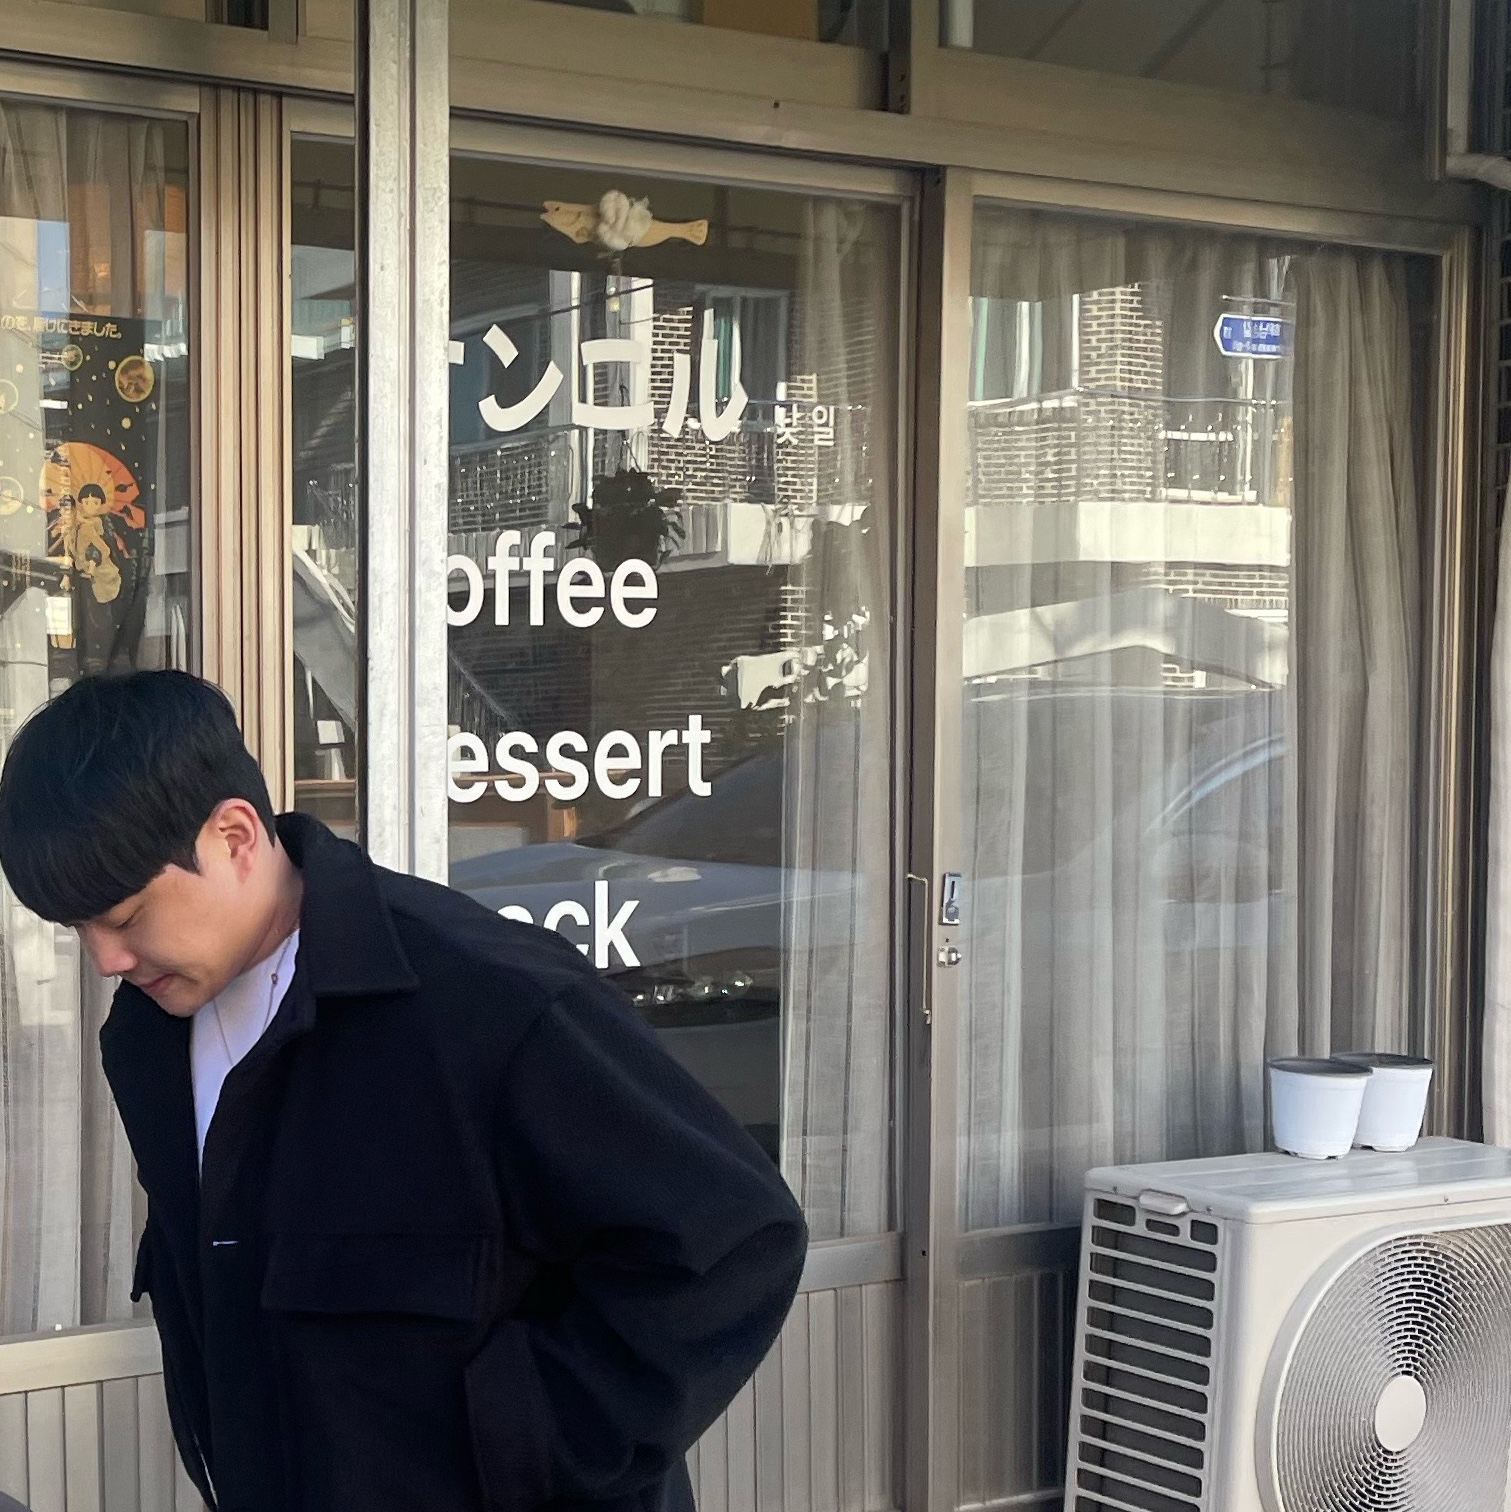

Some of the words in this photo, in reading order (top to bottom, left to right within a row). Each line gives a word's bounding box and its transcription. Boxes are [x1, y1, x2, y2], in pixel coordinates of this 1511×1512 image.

[448, 322, 749, 442] ンニル
[447, 529, 659, 628] offee
[447, 714, 713, 803] essert
